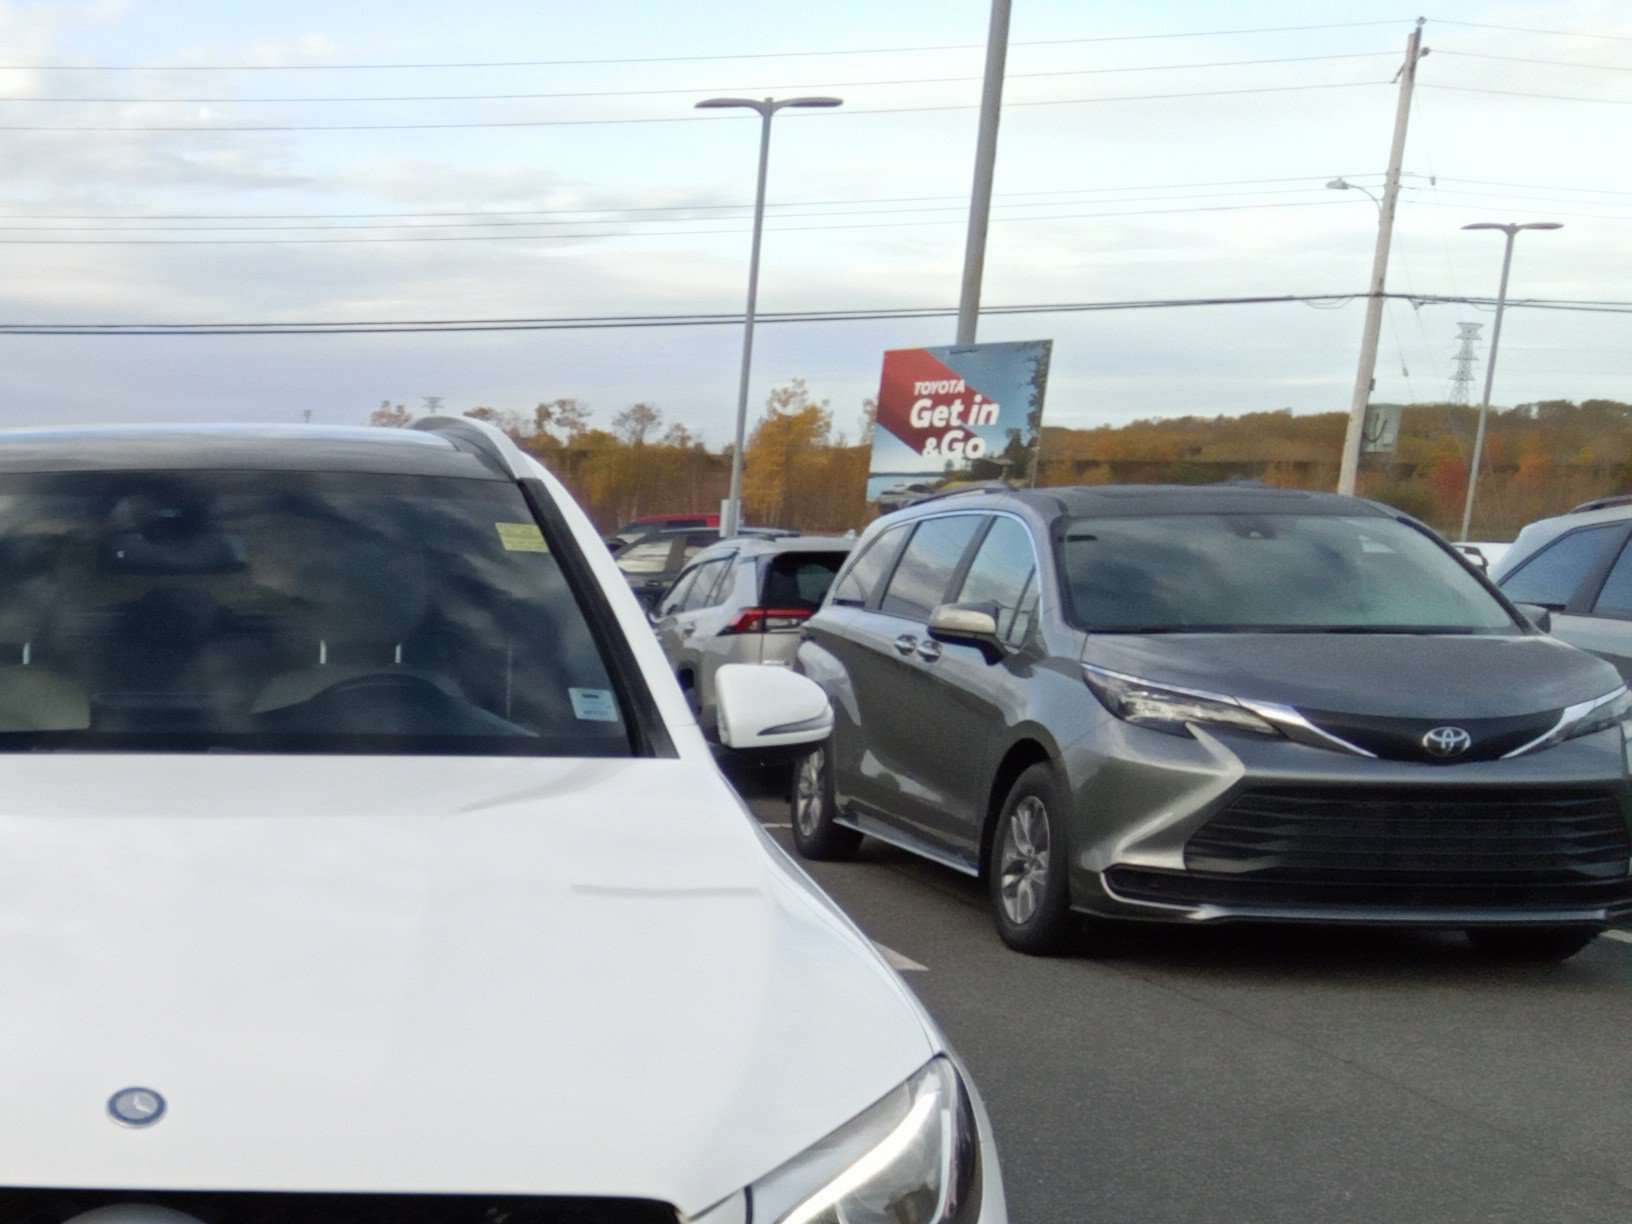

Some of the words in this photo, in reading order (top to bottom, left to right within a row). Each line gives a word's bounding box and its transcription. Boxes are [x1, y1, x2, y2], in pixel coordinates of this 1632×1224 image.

[914, 380, 966, 396] TOYOTA
[909, 399, 965, 428] Get
[968, 394, 1000, 426] in
